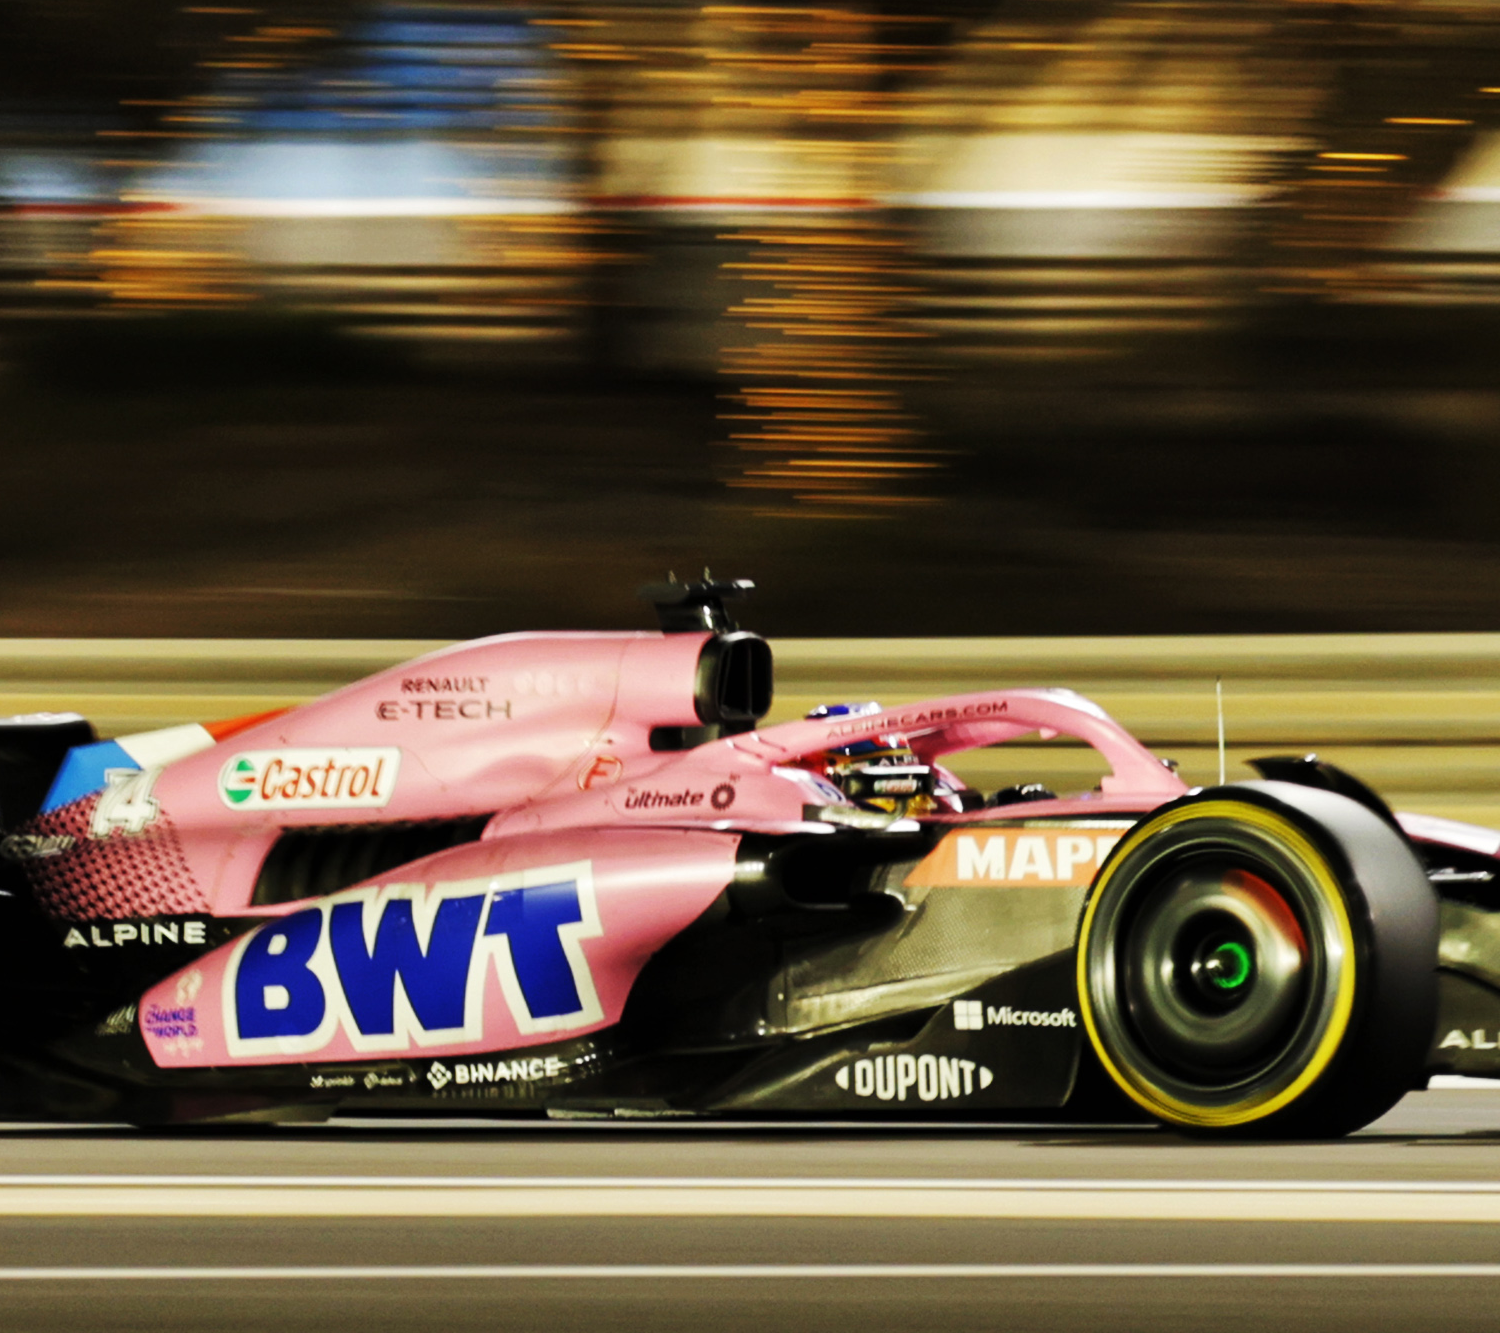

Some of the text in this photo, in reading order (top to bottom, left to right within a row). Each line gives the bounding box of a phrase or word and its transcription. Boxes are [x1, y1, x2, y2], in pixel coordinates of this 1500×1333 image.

[402, 677, 489, 694] RENAULT
[376, 699, 512, 721] E-TECH
[826, 700, 1009, 740] ALPINECARS.COM
[260, 756, 385, 801] Castrol
[624, 788, 705, 809] ultimate
[62, 921, 207, 948] ALPINE
[233, 878, 585, 1041] BWT
[986, 1005, 1078, 1028] Microsoft
[454, 1056, 561, 1085] BINANCE
[854, 1053, 977, 1102] DUPONT
